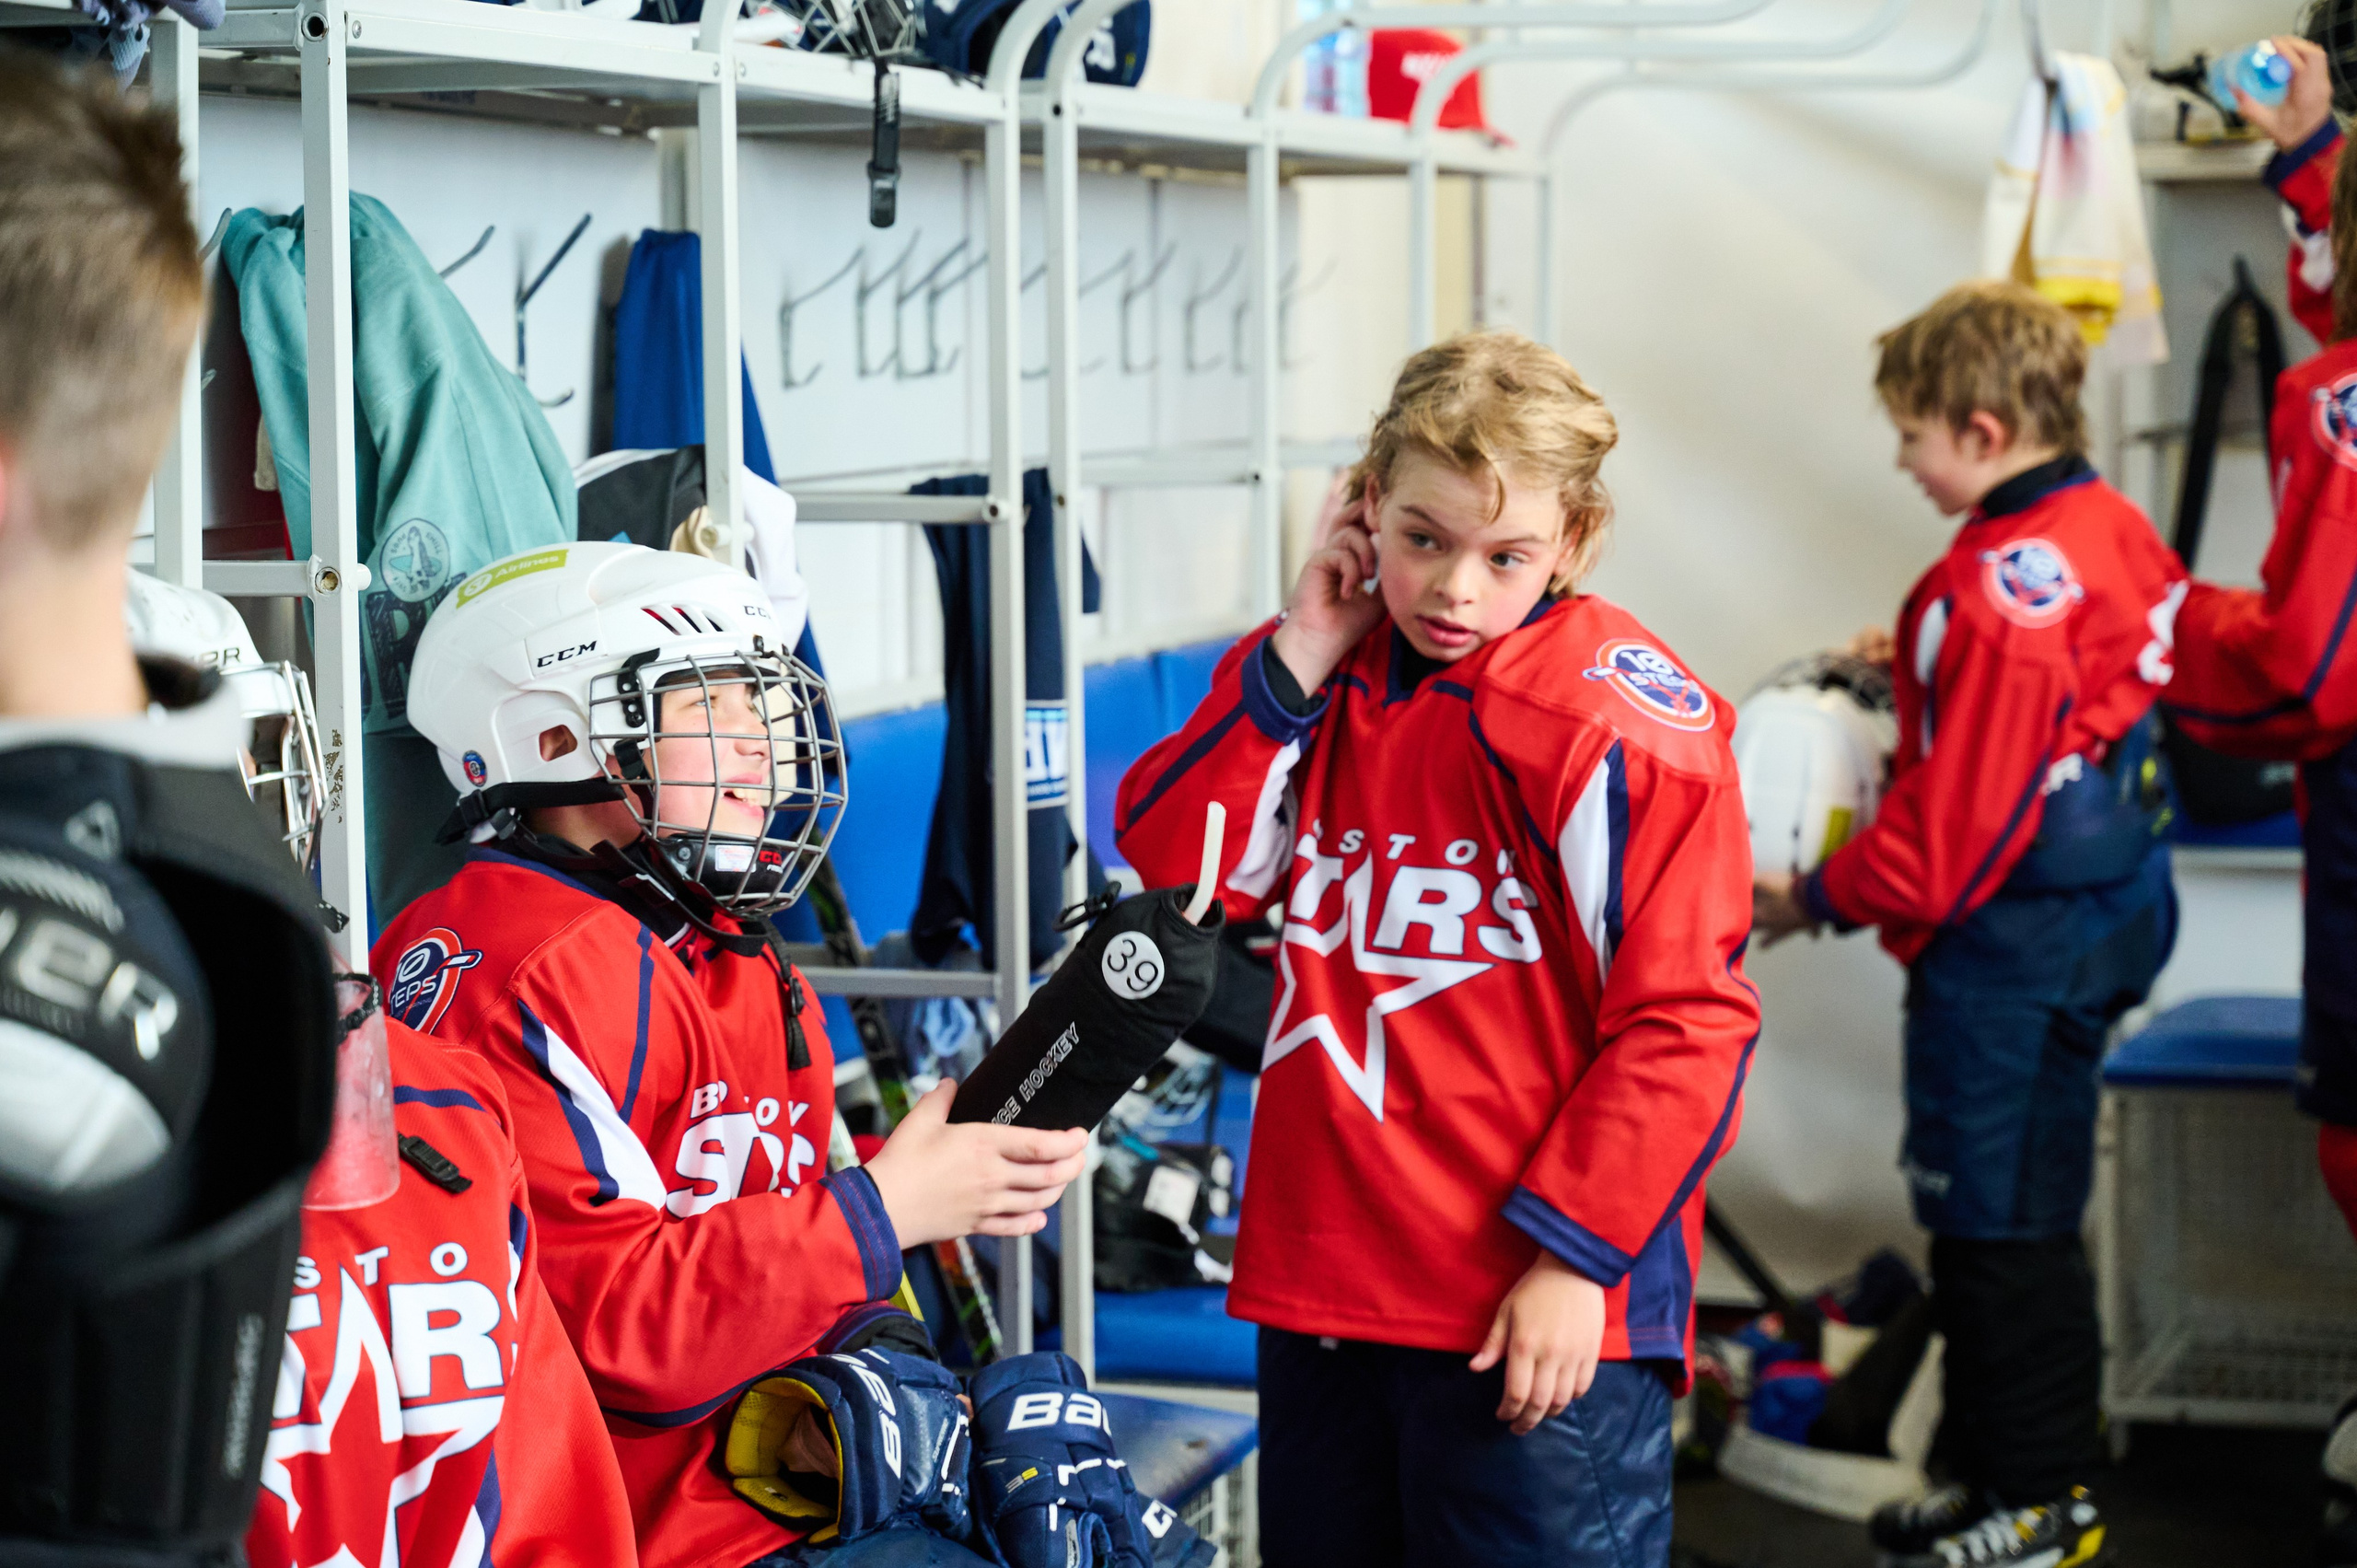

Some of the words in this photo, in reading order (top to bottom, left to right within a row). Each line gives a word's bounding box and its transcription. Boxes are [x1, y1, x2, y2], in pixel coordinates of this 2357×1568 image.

[495, 553, 560, 579] Airlines
[743, 604, 772, 621] CC
[537, 640, 598, 668] CCM
[1107, 938, 1159, 993] 39
[1018, 1020, 1081, 1103] HOCKEY
